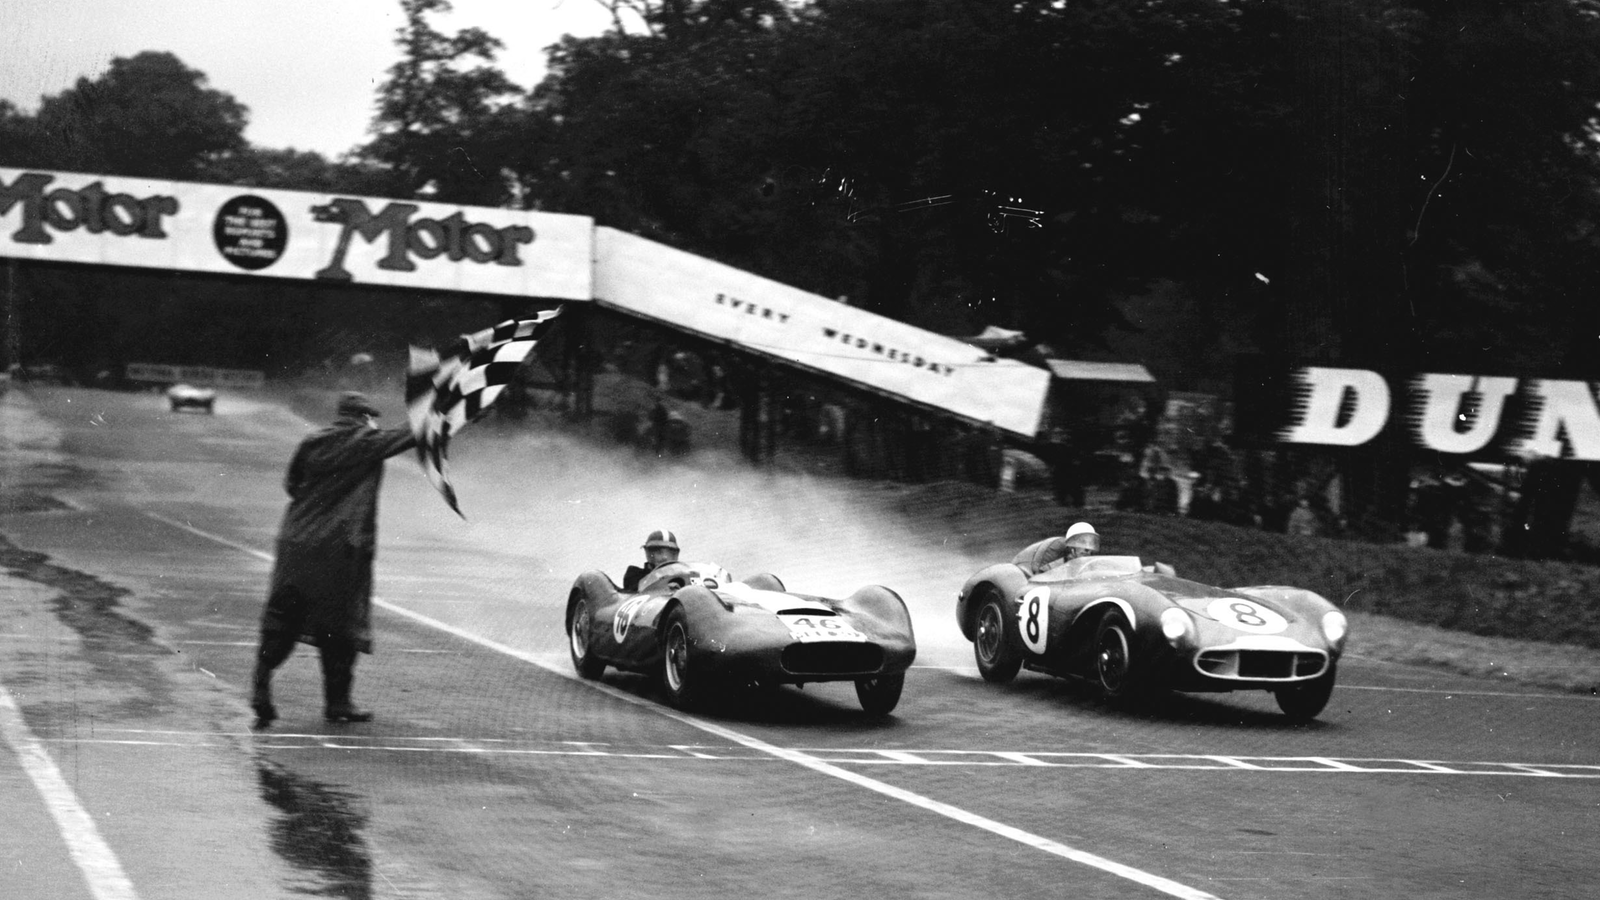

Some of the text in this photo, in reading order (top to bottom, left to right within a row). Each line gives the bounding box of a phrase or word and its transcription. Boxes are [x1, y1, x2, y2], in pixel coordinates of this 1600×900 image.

[315, 198, 535, 282] Motor
[715, 293, 957, 376] EVERY WEDNESDAY
[793, 617, 842, 630] 46
[1026, 595, 1041, 645] 8
[1229, 602, 1266, 627] 8
